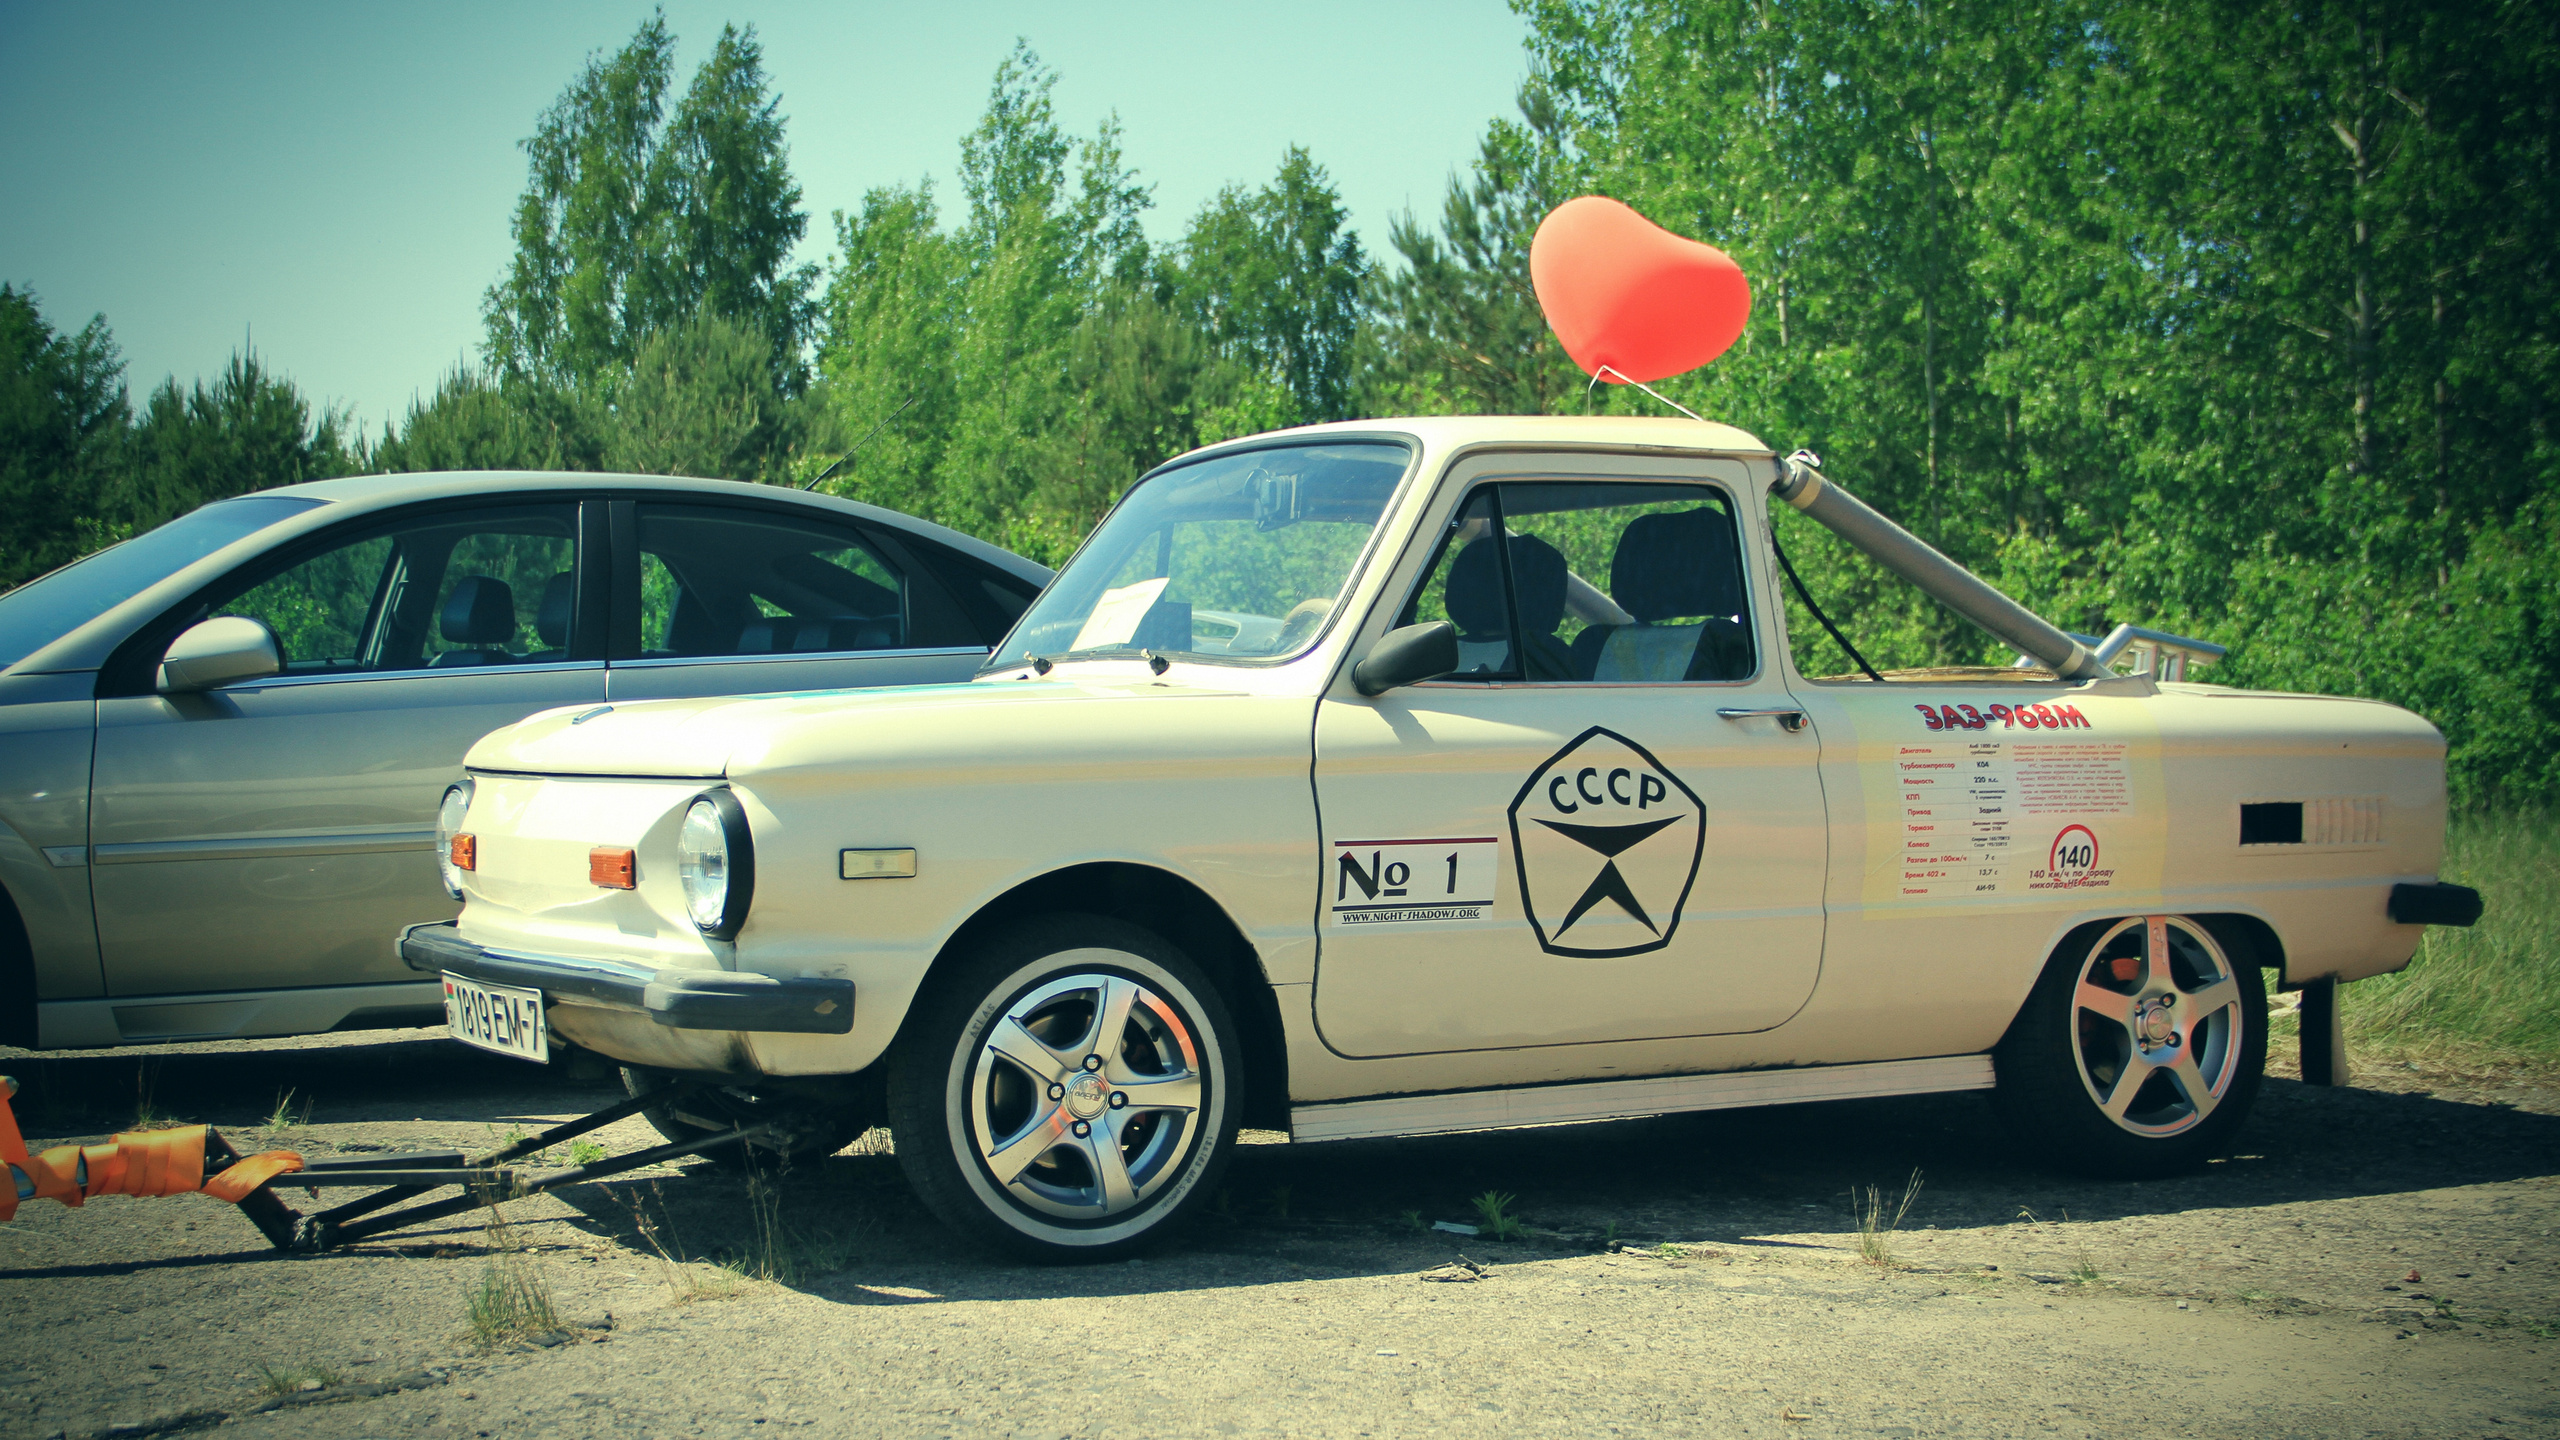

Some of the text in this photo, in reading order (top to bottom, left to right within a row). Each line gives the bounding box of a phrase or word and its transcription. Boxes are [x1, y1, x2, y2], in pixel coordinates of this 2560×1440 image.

[1914, 704, 2092, 732] ЗАЗ-968М
[1900, 762, 1955, 770] Турбокомпрессор
[1907, 808, 1931, 817] Привод
[1907, 824, 1934, 832] Тормоза
[2058, 845, 2091, 868] 140
[1446, 851, 1458, 894] 1
[1905, 871, 1924, 880] Время
[1979, 868, 1992, 876] 13,7
[2029, 869, 2045, 879] 140
[2048, 869, 2069, 878] км/ч
[2029, 881, 2063, 889] никогда
[2067, 878, 2079, 887] НЕ
[1342, 908, 1480, 922] WWW.NIGHT-SHADOWS.ORG
[970, 1003, 995, 1038] ATLAS
